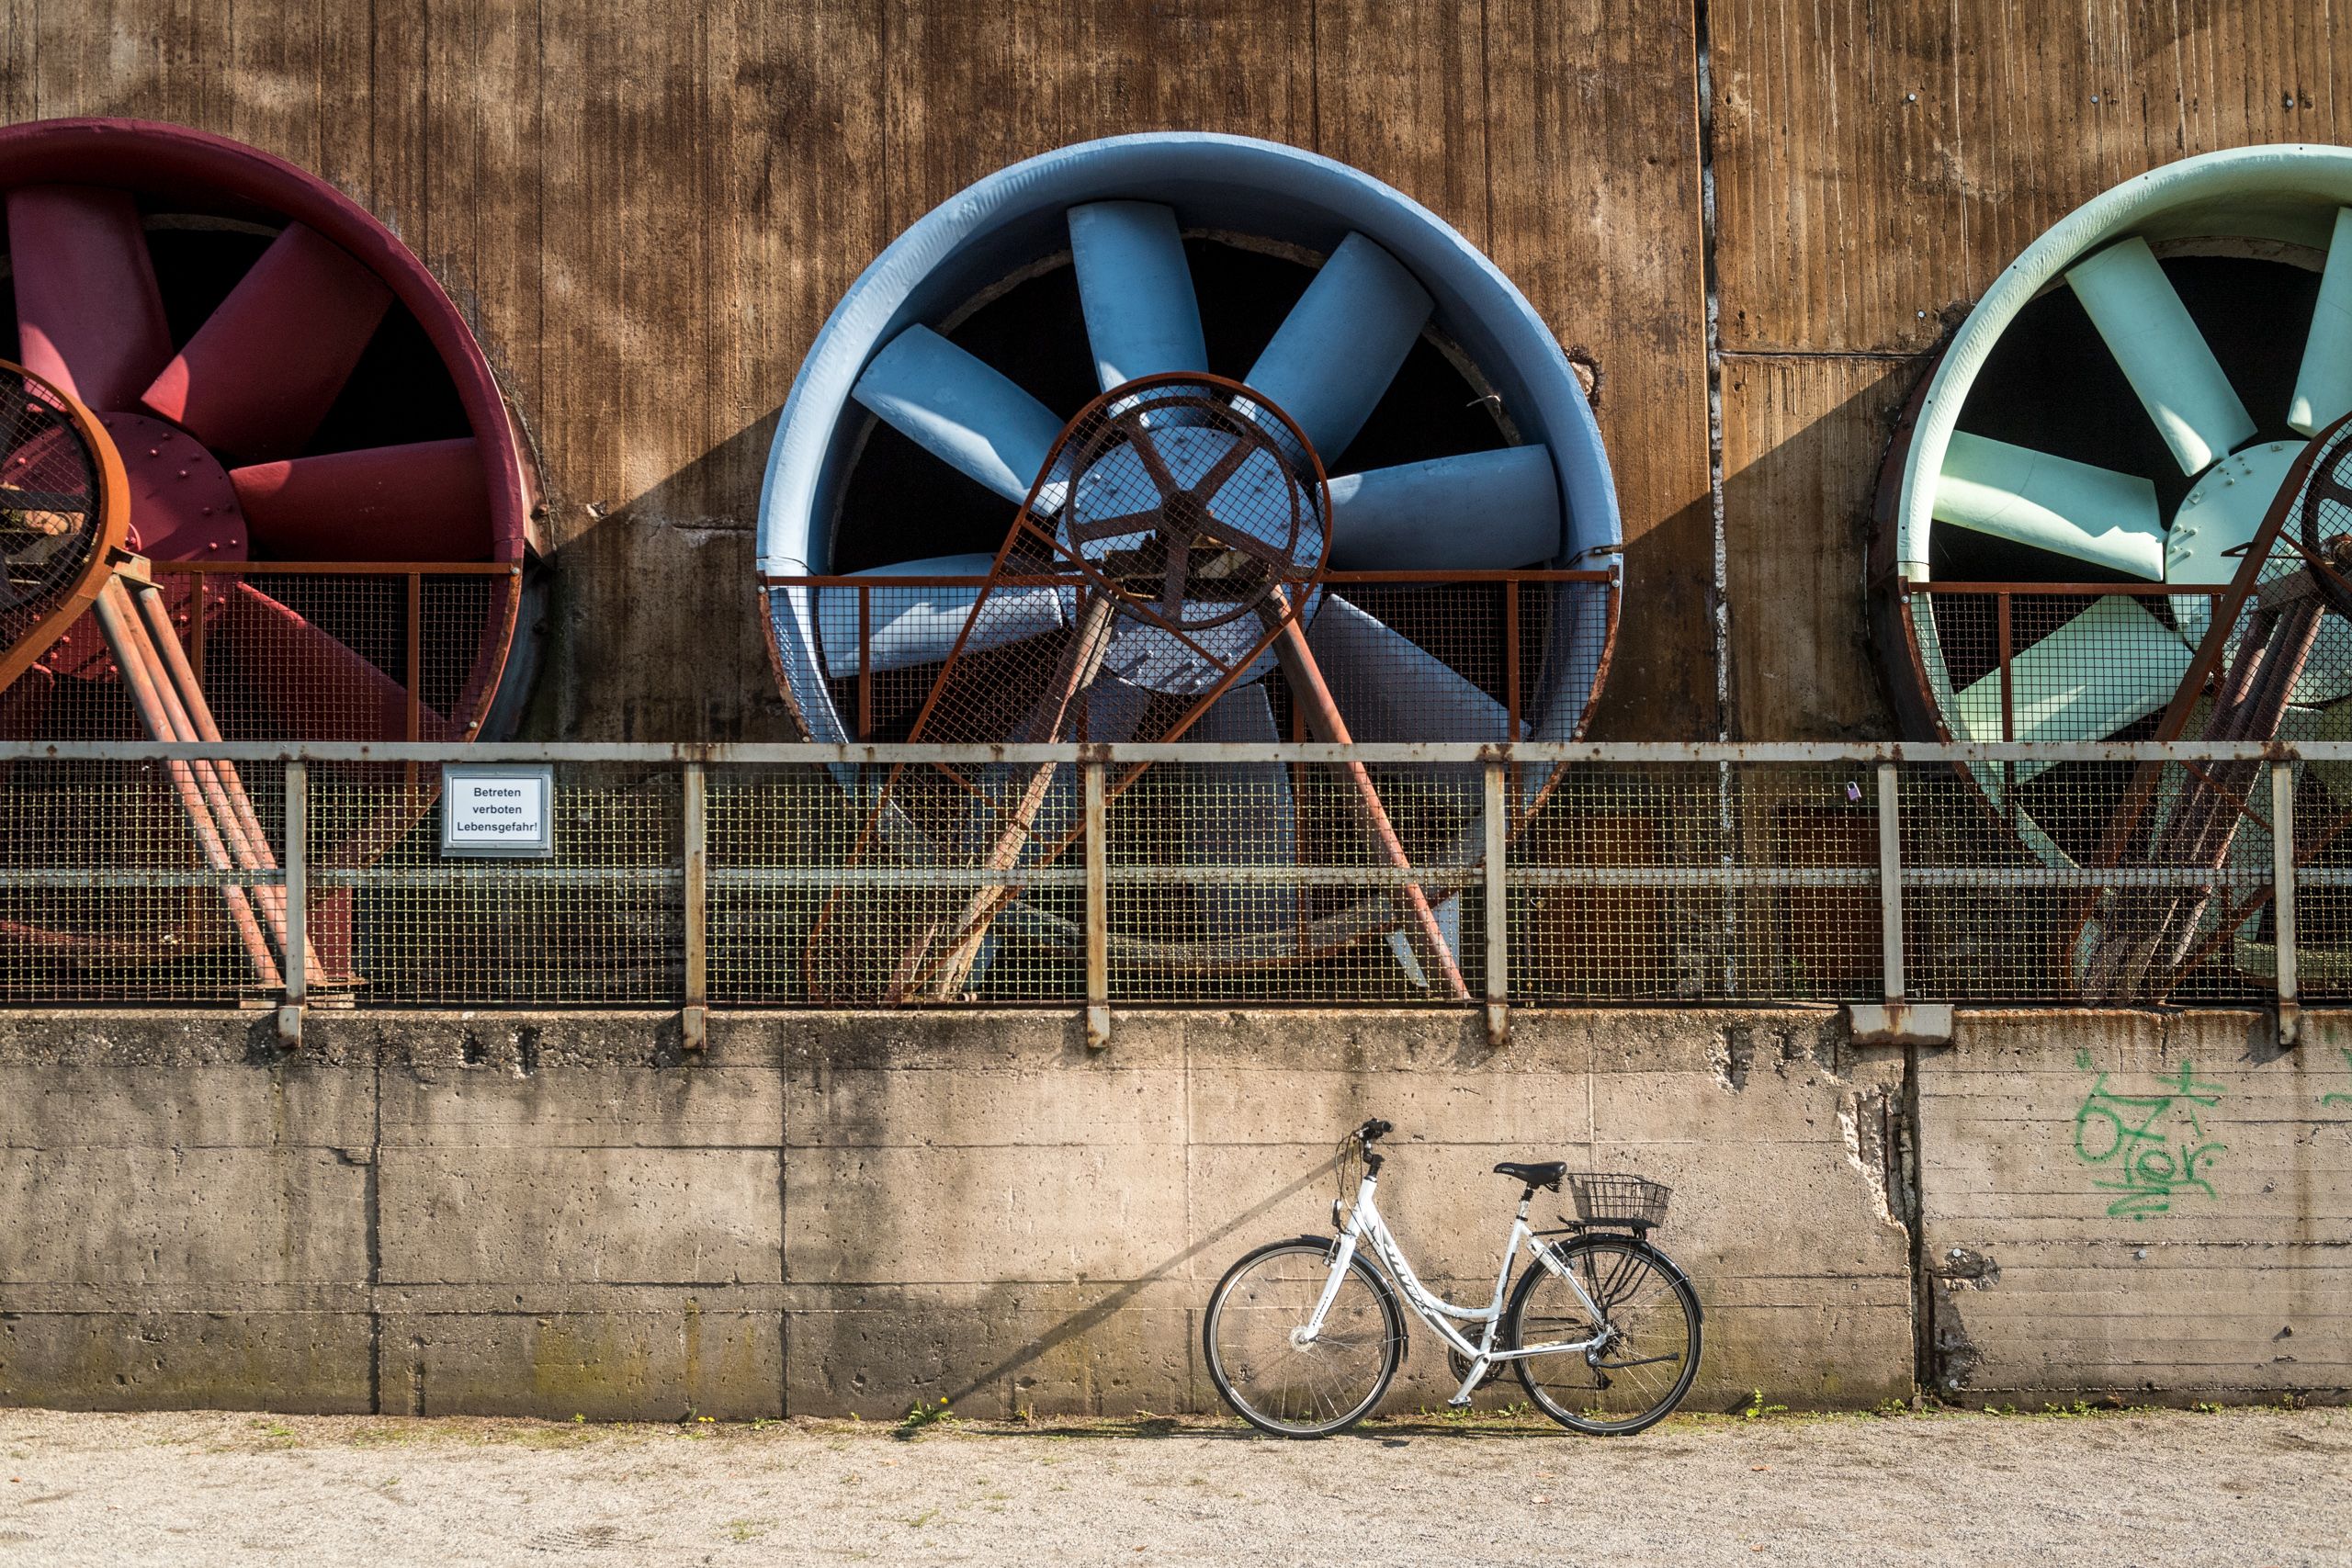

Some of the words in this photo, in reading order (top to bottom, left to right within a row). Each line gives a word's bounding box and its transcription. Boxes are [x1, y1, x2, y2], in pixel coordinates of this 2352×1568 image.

[474, 787, 521, 797] Betreten
[473, 805, 522, 814] verboten
[458, 821, 537, 833] Lebensgefahr!
